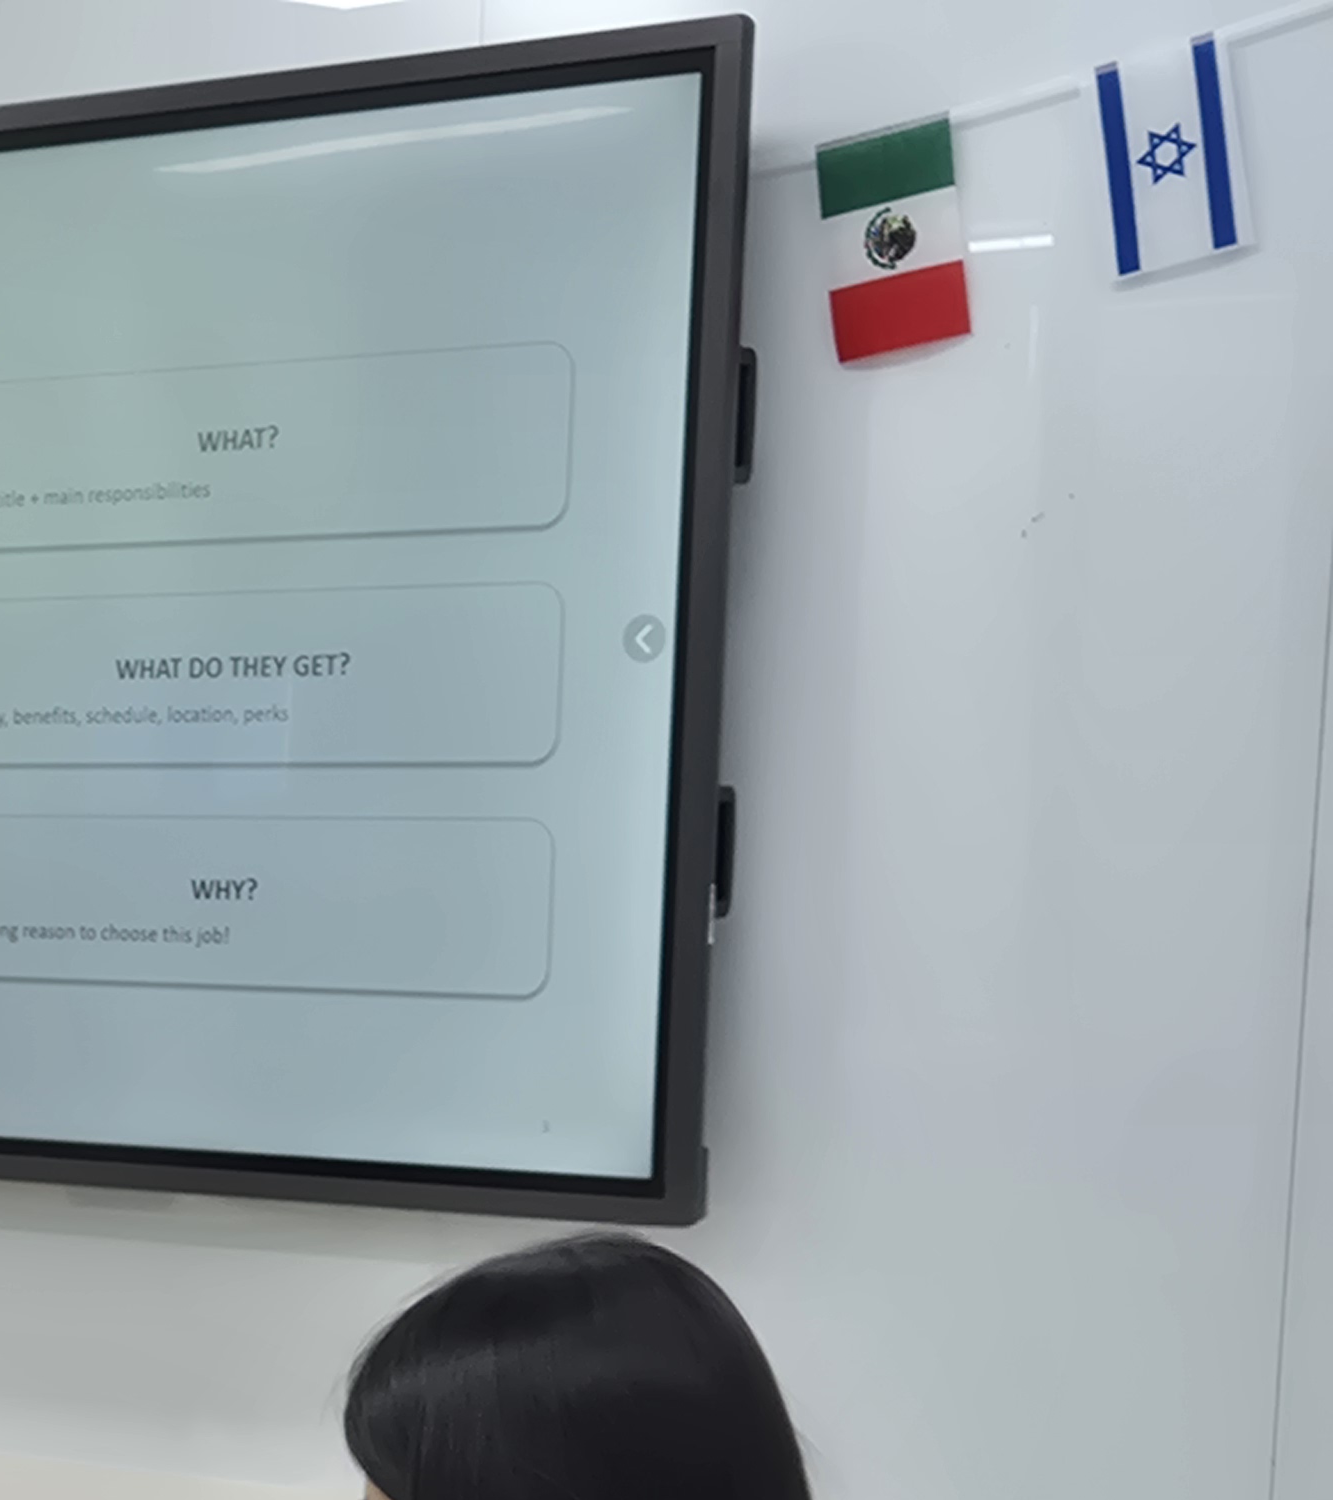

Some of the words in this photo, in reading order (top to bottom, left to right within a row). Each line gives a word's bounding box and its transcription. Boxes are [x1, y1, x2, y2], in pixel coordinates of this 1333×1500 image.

[197, 425, 280, 453] WHAT?
[43, 488, 84, 505] main
[87, 481, 211, 506] responsibilities
[116, 657, 183, 680] WHAT
[187, 656, 223, 680] DO
[230, 654, 286, 678] THEY
[292, 652, 351, 677] GET?
[13, 705, 81, 726] benefits,
[85, 705, 162, 725] schedule,
[166, 704, 238, 725] location,
[243, 704, 289, 725] perks
[190, 877, 258, 901] WHY?
[22, 924, 75, 940] reason
[79, 923, 97, 940] to
[100, 922, 157, 942] choose
[162, 924, 193, 943] this
[194, 924, 230, 947] job!
